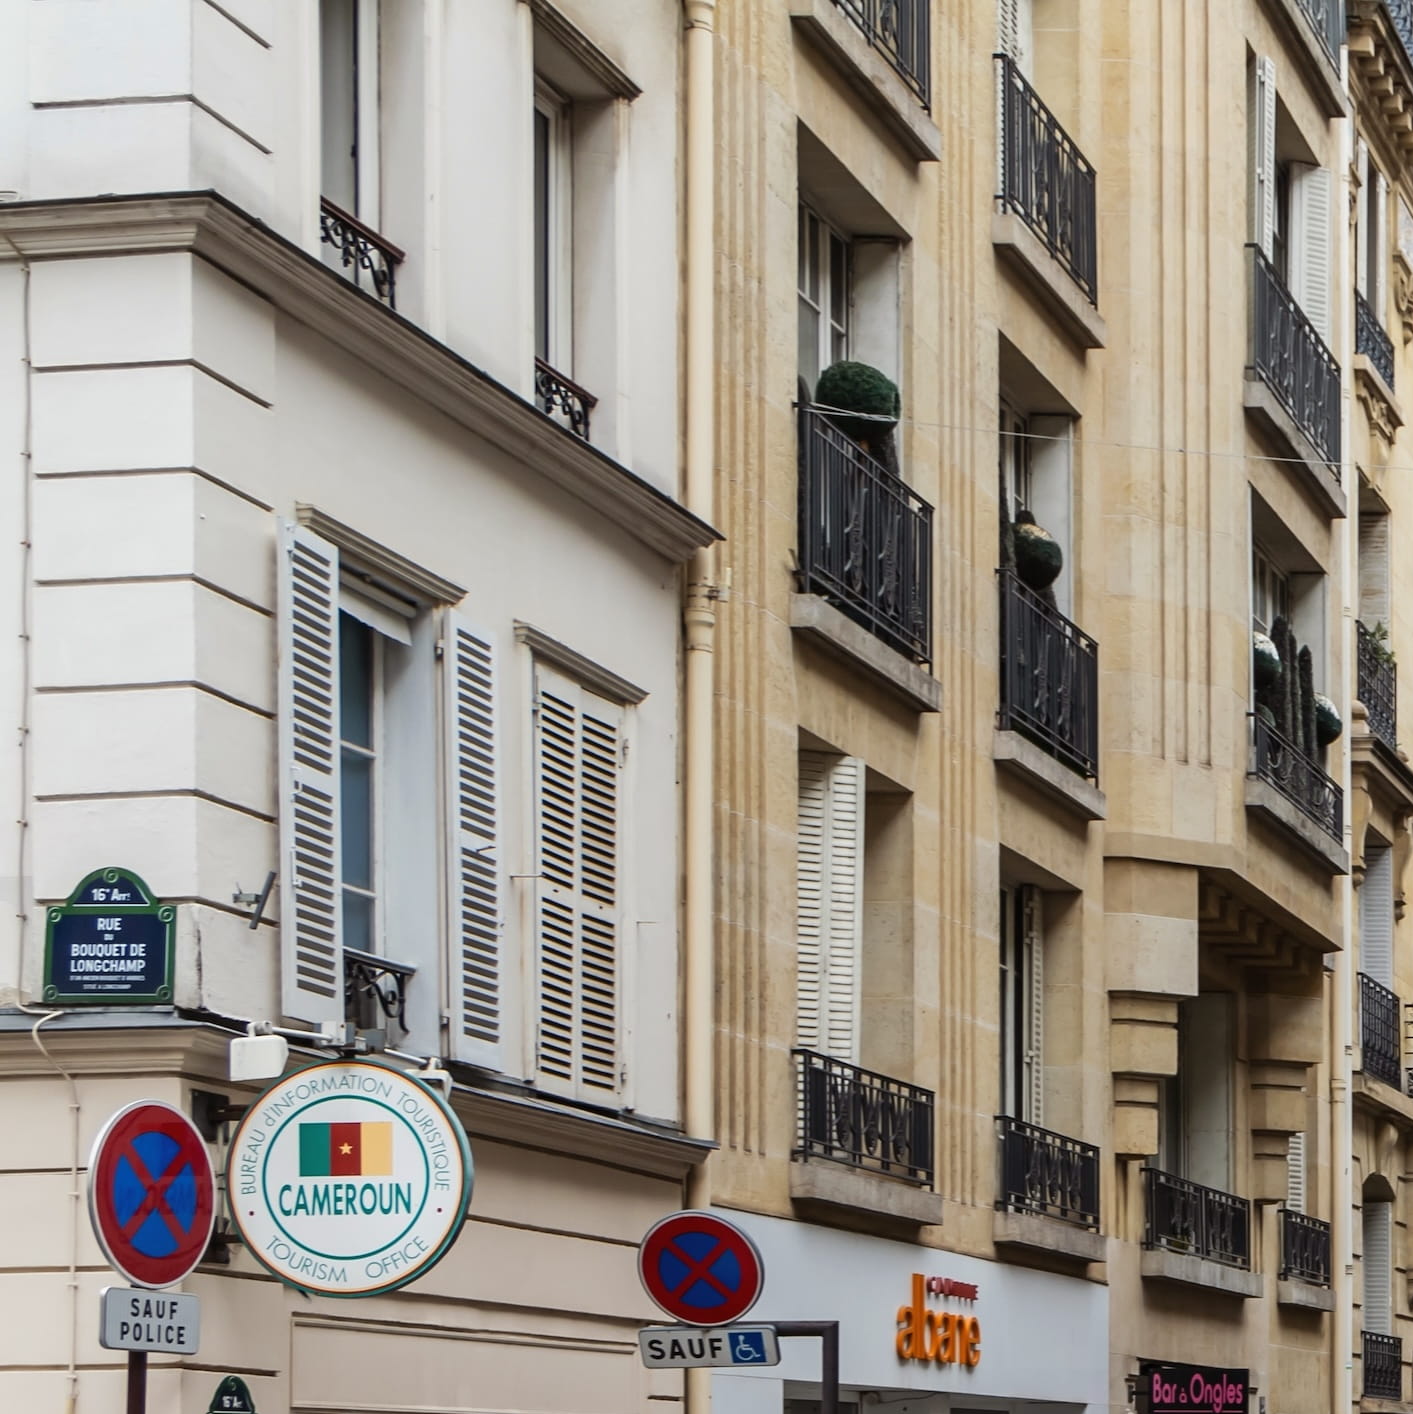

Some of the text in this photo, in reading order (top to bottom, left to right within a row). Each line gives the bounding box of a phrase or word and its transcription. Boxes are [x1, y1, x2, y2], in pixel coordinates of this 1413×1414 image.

[97, 917, 122, 931] RUE
[71, 943, 147, 957] BOUQUET DE
[70, 959, 146, 973] LONGCHAMP
[241, 1074, 451, 1195] BUREAU d'INFORMATION TOURISTIQUE
[279, 1182, 412, 1217] CAMEROUN
[265, 1235, 429, 1283] TOURISM OFFICE
[130, 1298, 179, 1320] SAUF
[120, 1322, 186, 1345] POLICE
[649, 1338, 724, 1360] SAUF
[1153, 1373, 1177, 1404] Bar
[1190, 1373, 1244, 1413] Ongles
